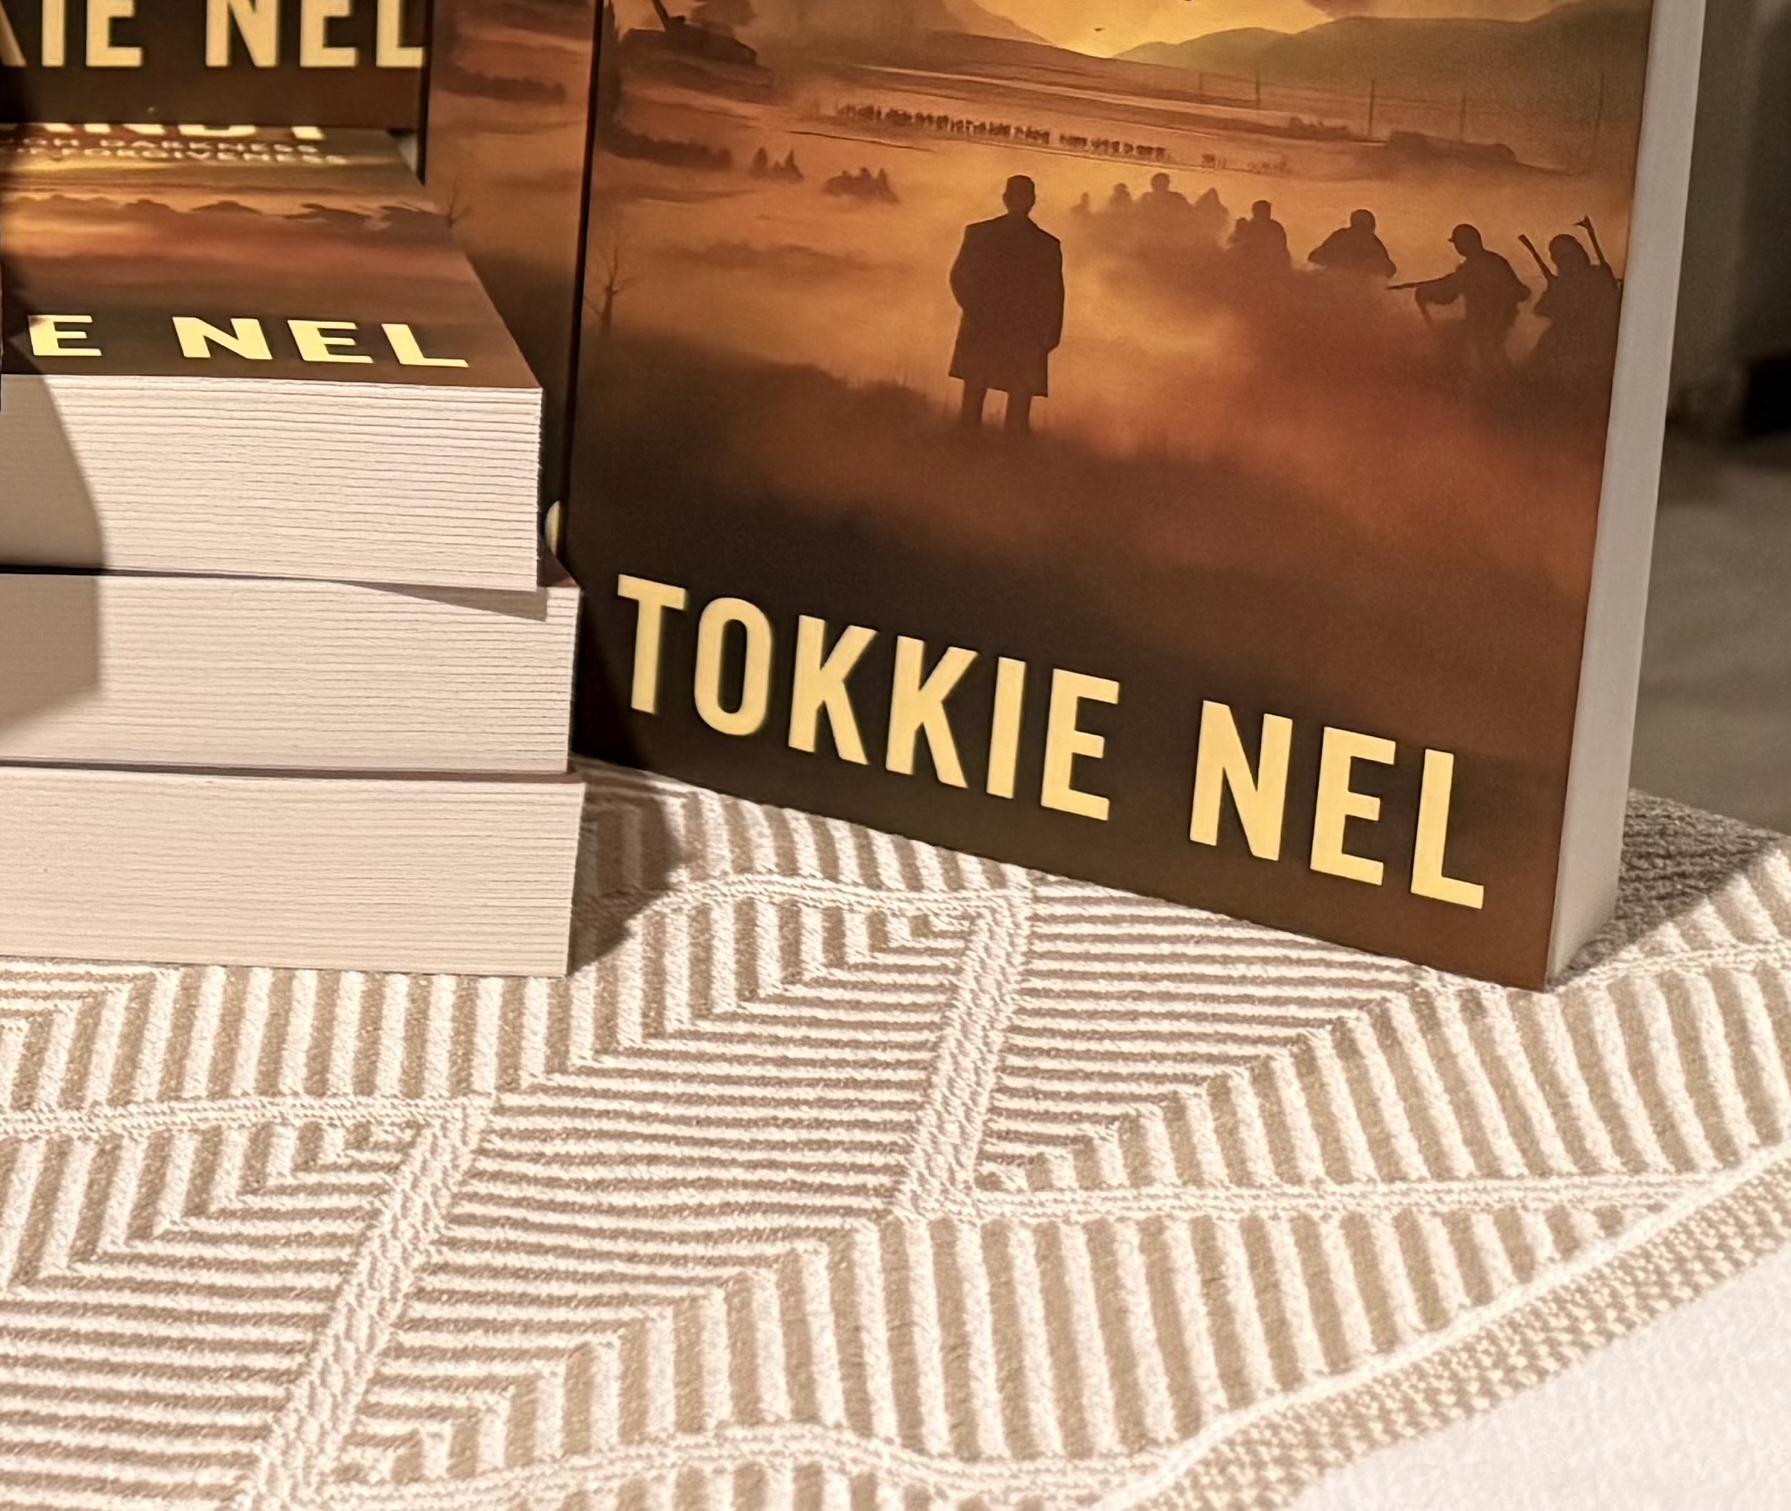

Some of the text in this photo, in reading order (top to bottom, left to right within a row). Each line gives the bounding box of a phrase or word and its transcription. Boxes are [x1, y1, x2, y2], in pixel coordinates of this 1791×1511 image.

[171, 315, 469, 368] NEL
[617, 571, 1484, 910] TOKKIE NEL
